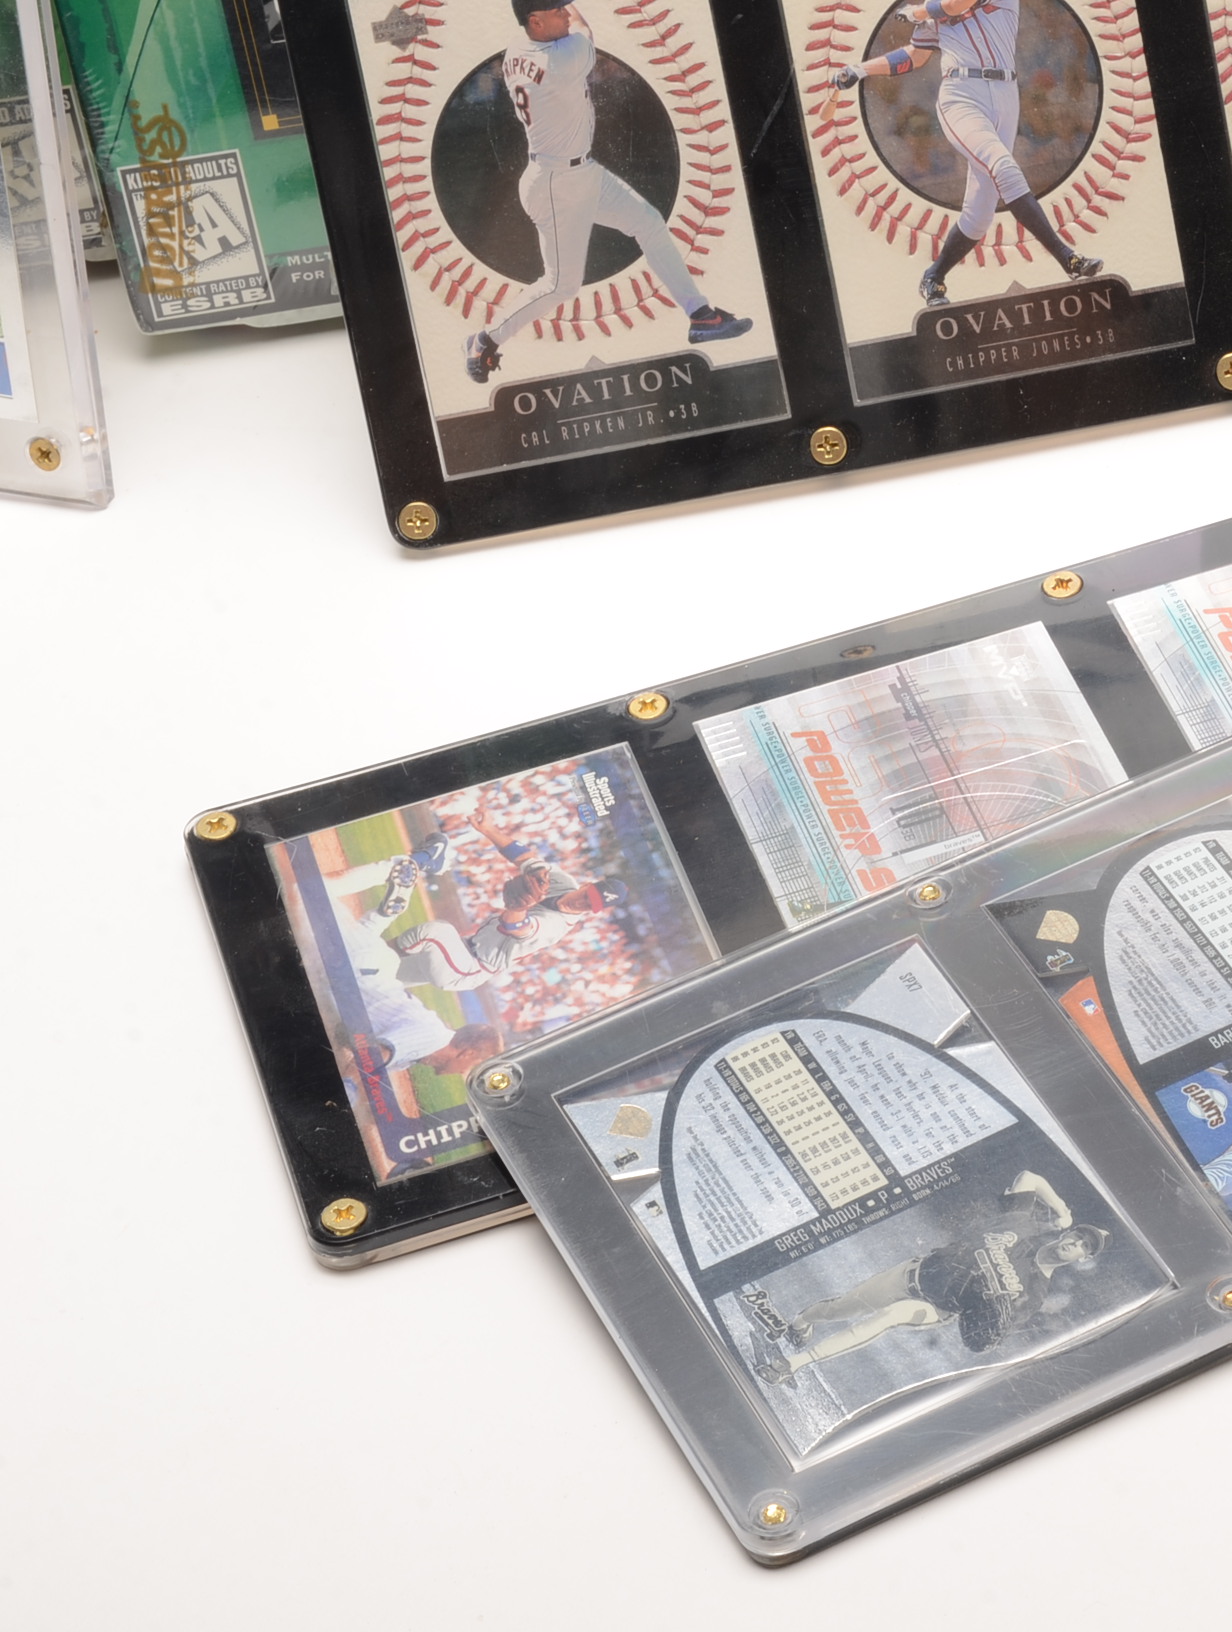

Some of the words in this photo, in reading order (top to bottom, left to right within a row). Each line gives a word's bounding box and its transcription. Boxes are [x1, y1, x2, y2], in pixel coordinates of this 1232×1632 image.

[505, 58, 544, 85] RIPKEN
[126, 169, 161, 190] KIDS
[186, 158, 239, 179] ADULTS
[158, 285, 207, 302] CONTENT
[210, 280, 246, 297] RATED
[250, 275, 264, 288] BY
[291, 270, 325, 283] FOR
[160, 288, 267, 316] ESRB
[935, 288, 1113, 341] OVATION
[946, 346, 1020, 373] CHIPPER
[513, 362, 693, 416] OVATION
[520, 428, 550, 448] CAL
[561, 416, 626, 441] RIPKEN
[898, 691, 919, 718] chipper
[906, 722, 937, 754] JONES
[582, 771, 610, 817] Illustrated
[596, 776, 616, 806] Sports
[791, 730, 882, 859] POWER
[898, 971, 922, 993] SPX7
[353, 1033, 375, 1073] Atlanta
[1180, 1082, 1226, 1128] GIANTS
[773, 1227, 810, 1252] GREG
[808, 1201, 866, 1235] MADDUX
[876, 1189, 892, 1203] P
[984, 1232, 1023, 1291] Braves
[742, 1290, 788, 1329] Braves
